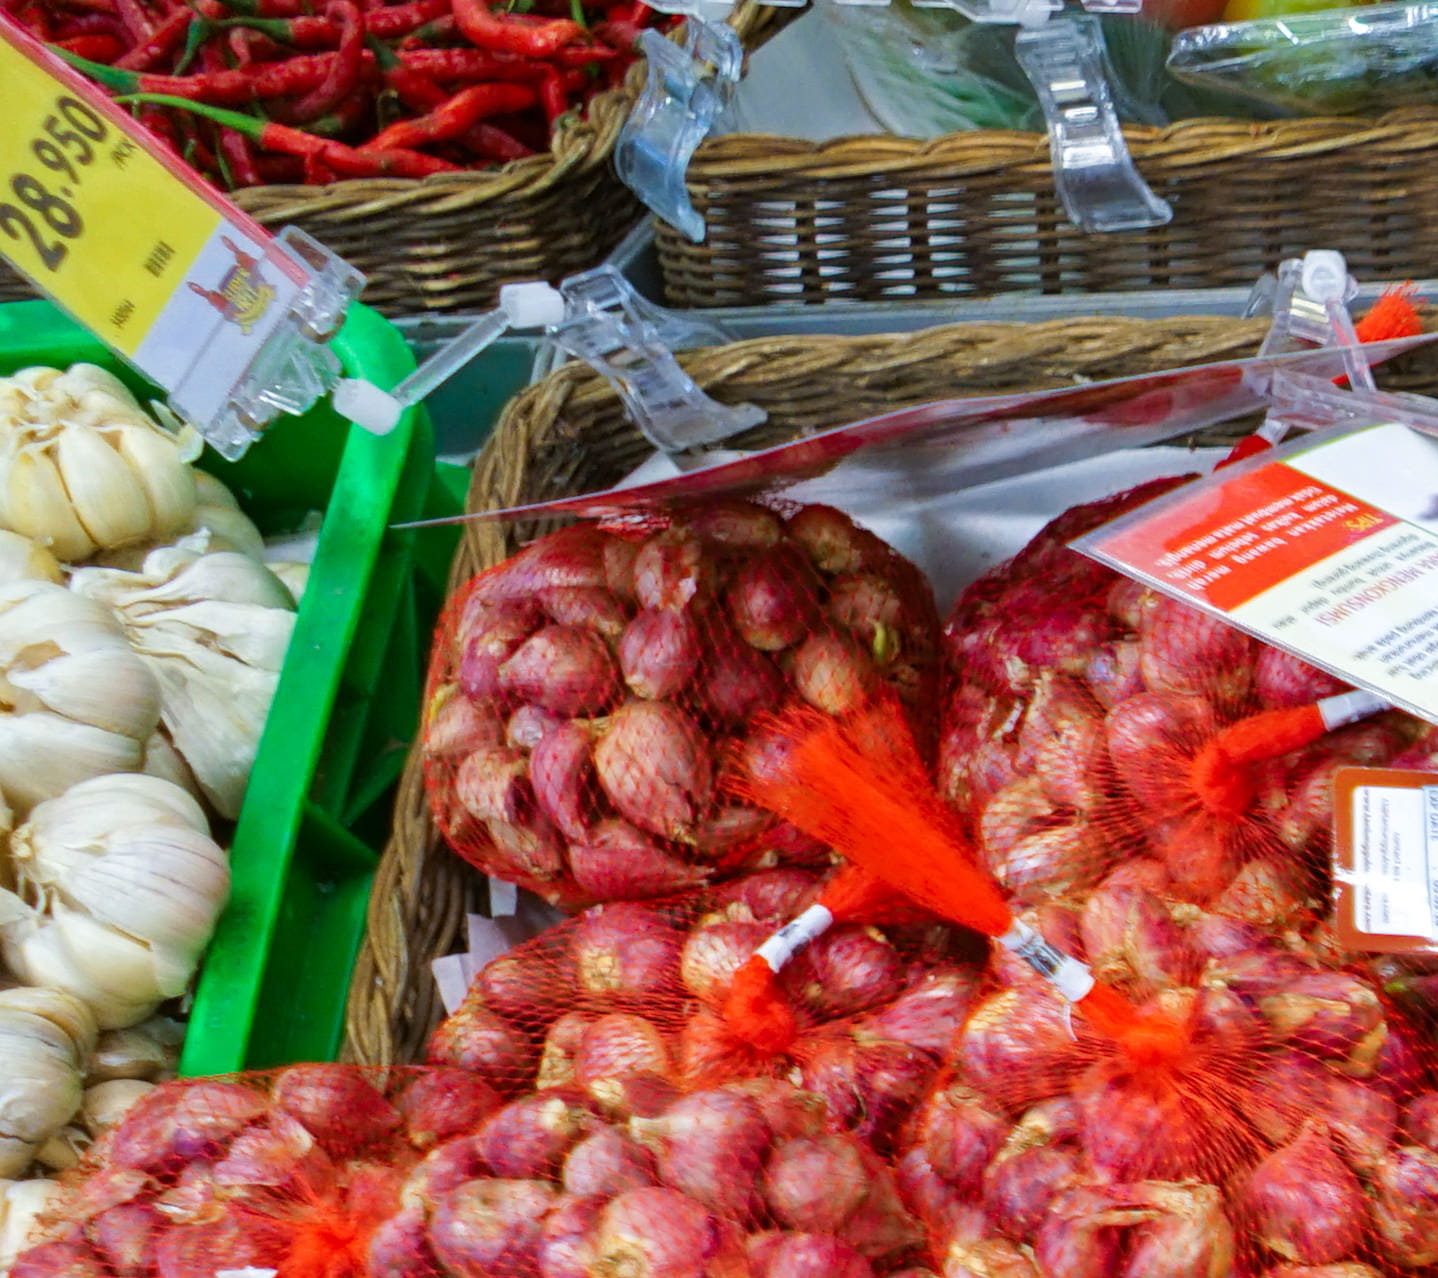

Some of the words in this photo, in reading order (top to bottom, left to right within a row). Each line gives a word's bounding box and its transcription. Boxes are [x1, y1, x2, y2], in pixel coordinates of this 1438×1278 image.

[0, 95, 108, 273] 28.950
[1238, 496, 1297, 527] membuat
[1299, 492, 1341, 514] dalam
[1210, 520, 1248, 540] mata
[1258, 509, 1305, 535] kulkas
[1284, 499, 1360, 540] Meletakkan
[1205, 530, 1263, 561] sebelum
[1228, 534, 1289, 566] bawang
[1182, 563, 1237, 593] merah
[1309, 564, 1429, 628] MENGKONSUMSI
